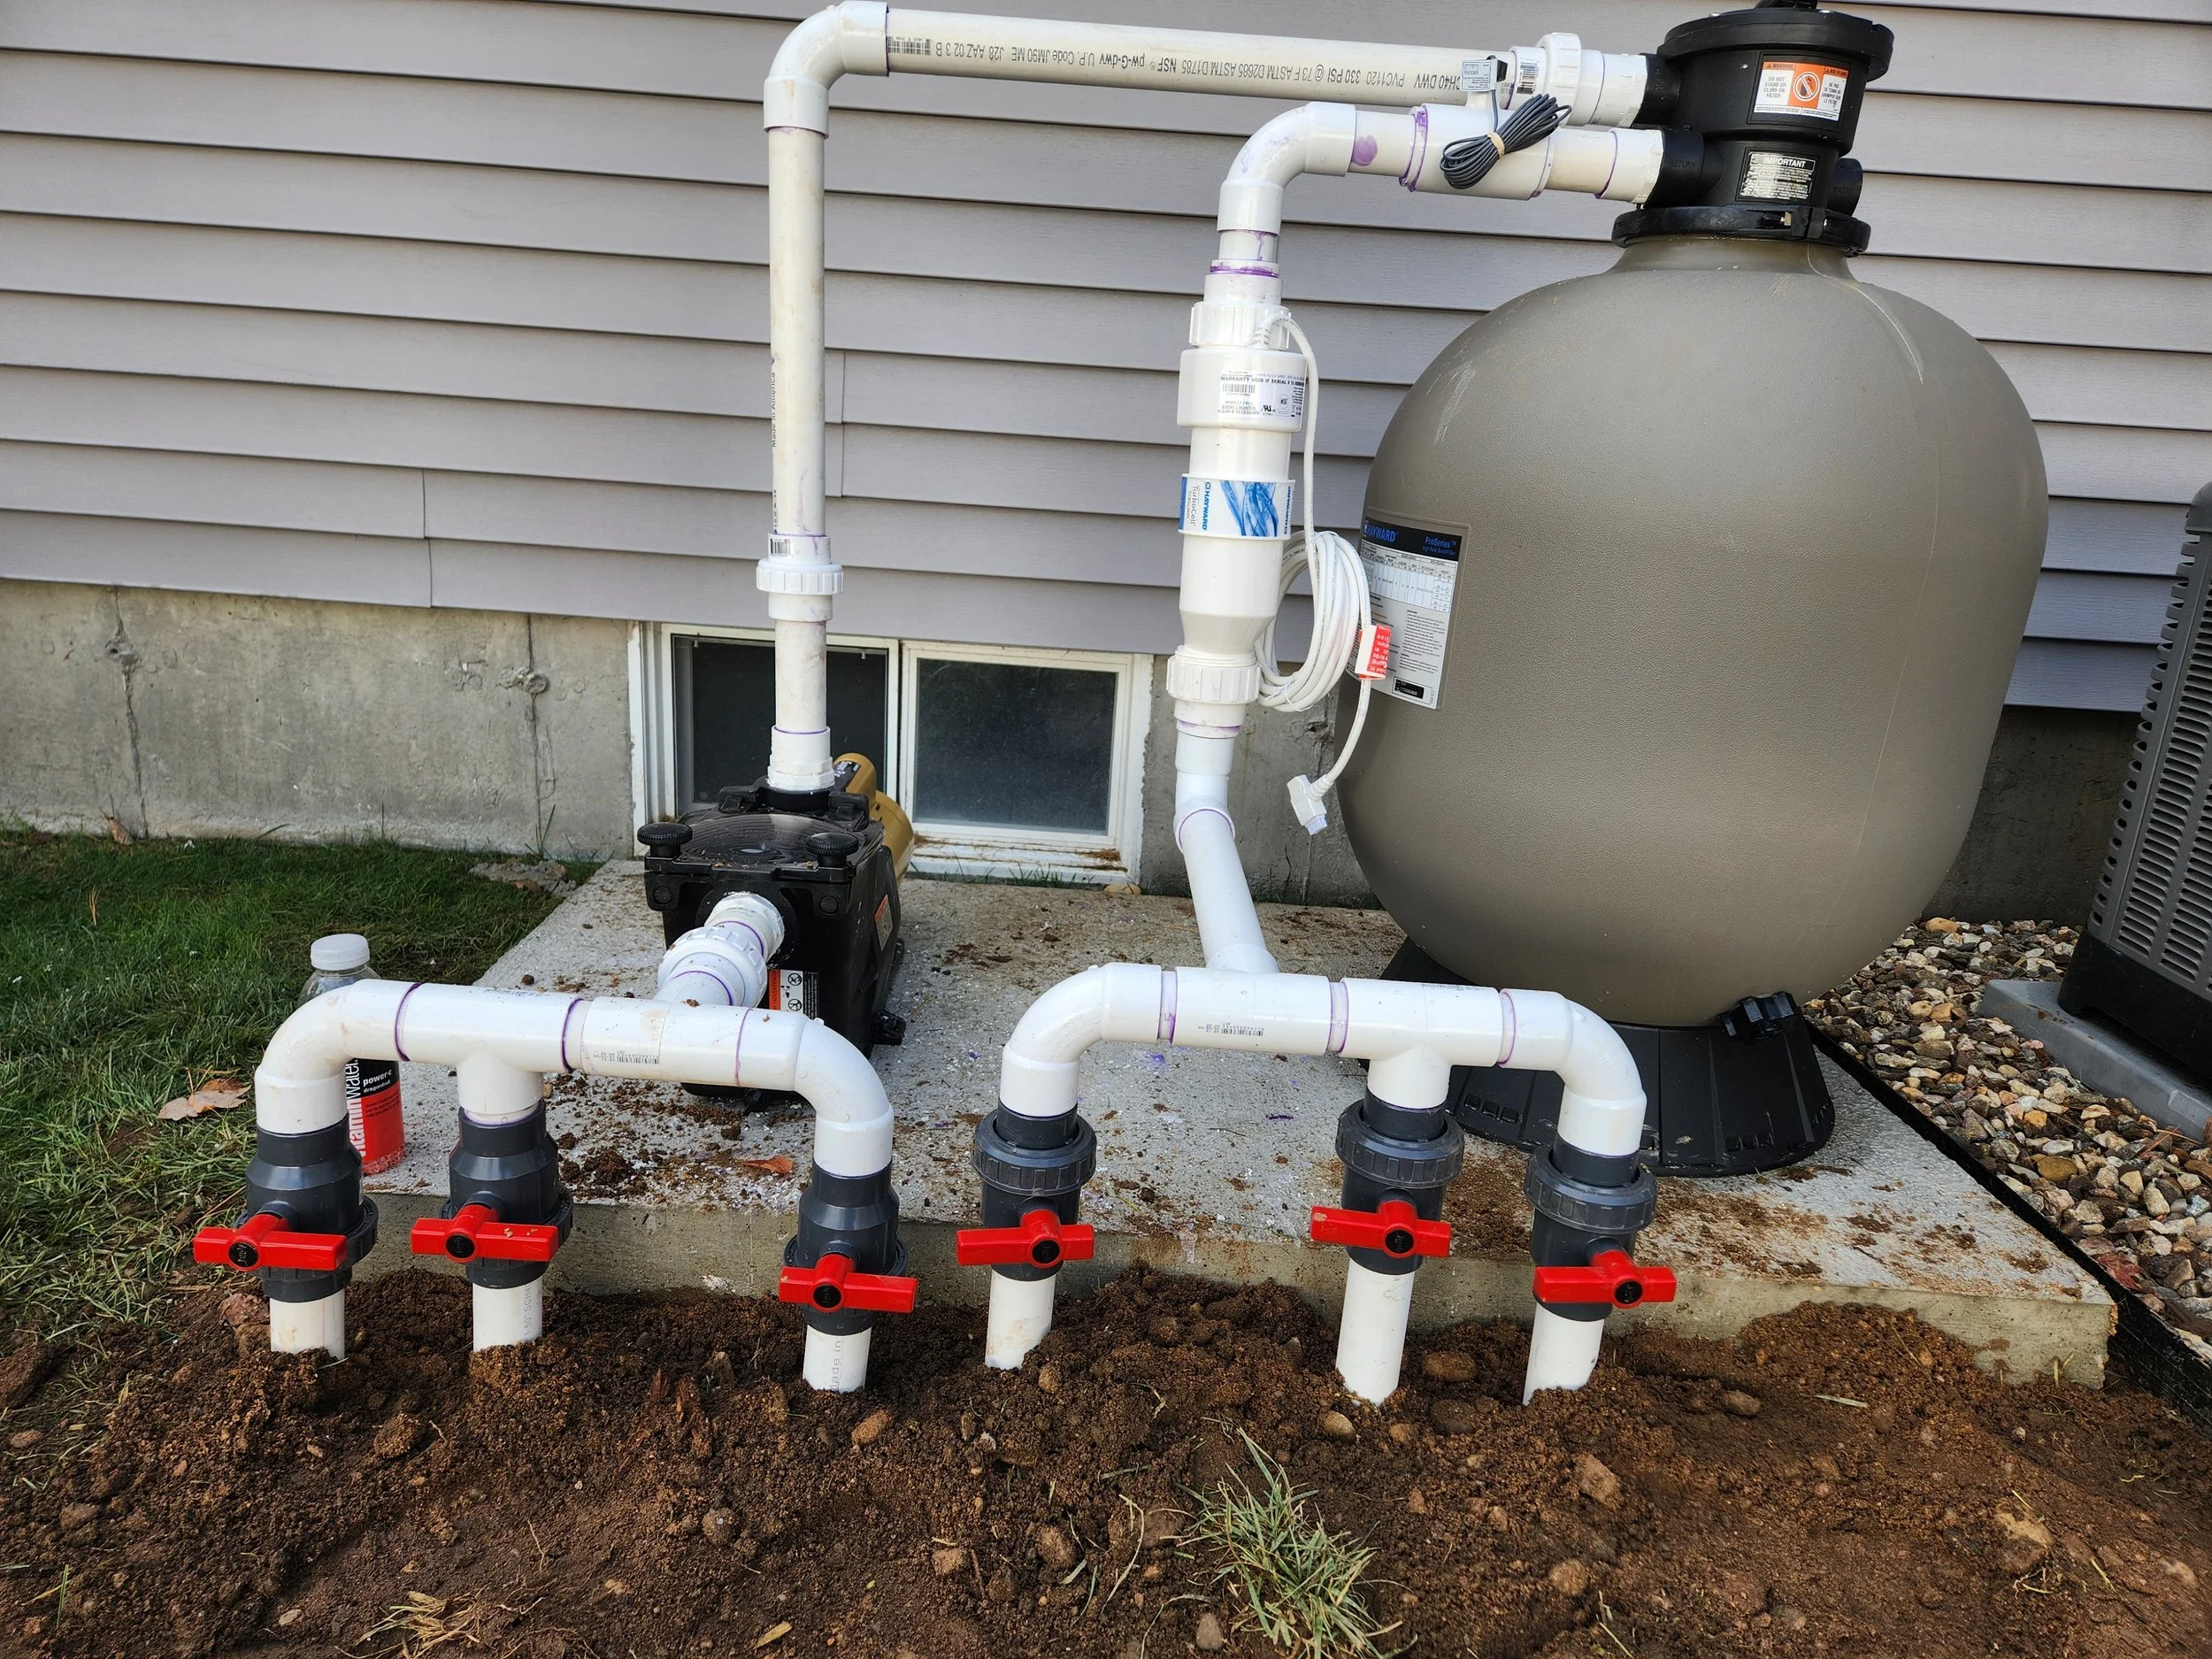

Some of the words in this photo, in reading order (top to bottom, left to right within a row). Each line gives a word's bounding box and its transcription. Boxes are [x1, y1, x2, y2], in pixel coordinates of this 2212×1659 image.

[935, 42, 942, 57] B
[946, 42, 951, 56] 3
[954, 42, 964, 58] 02
[966, 43, 986, 58] AAZ
[988, 46, 1004, 61] J28
[1011, 47, 1025, 61] ME
[1027, 48, 1050, 64] JM90
[1053, 50, 1075, 65] Code
[1078, 51, 1094, 66] U.P.
[1099, 52, 1145, 69] pw-G-dwv
[1181, 59, 1209, 76] D1785
[1210, 61, 1237, 77] ASTM
[1238, 63, 1265, 79] D2665
[1267, 65, 1294, 81] ASTM
[1294, 66, 1301, 81] F
[1302, 66, 1314, 81] 73
[1315, 64, 1325, 82] @
[1327, 67, 1344, 83] PSI
[1344, 69, 1361, 84] 330
[1365, 71, 1405, 88] PVC1120
[1414, 73, 1437, 88] DWV
[1763, 157, 1807, 169] IMPORTANT
[1366, 524, 1396, 542] HAYWARD
[363, 1069, 392, 1087] power-c
[834, 1341, 841, 1352] in
